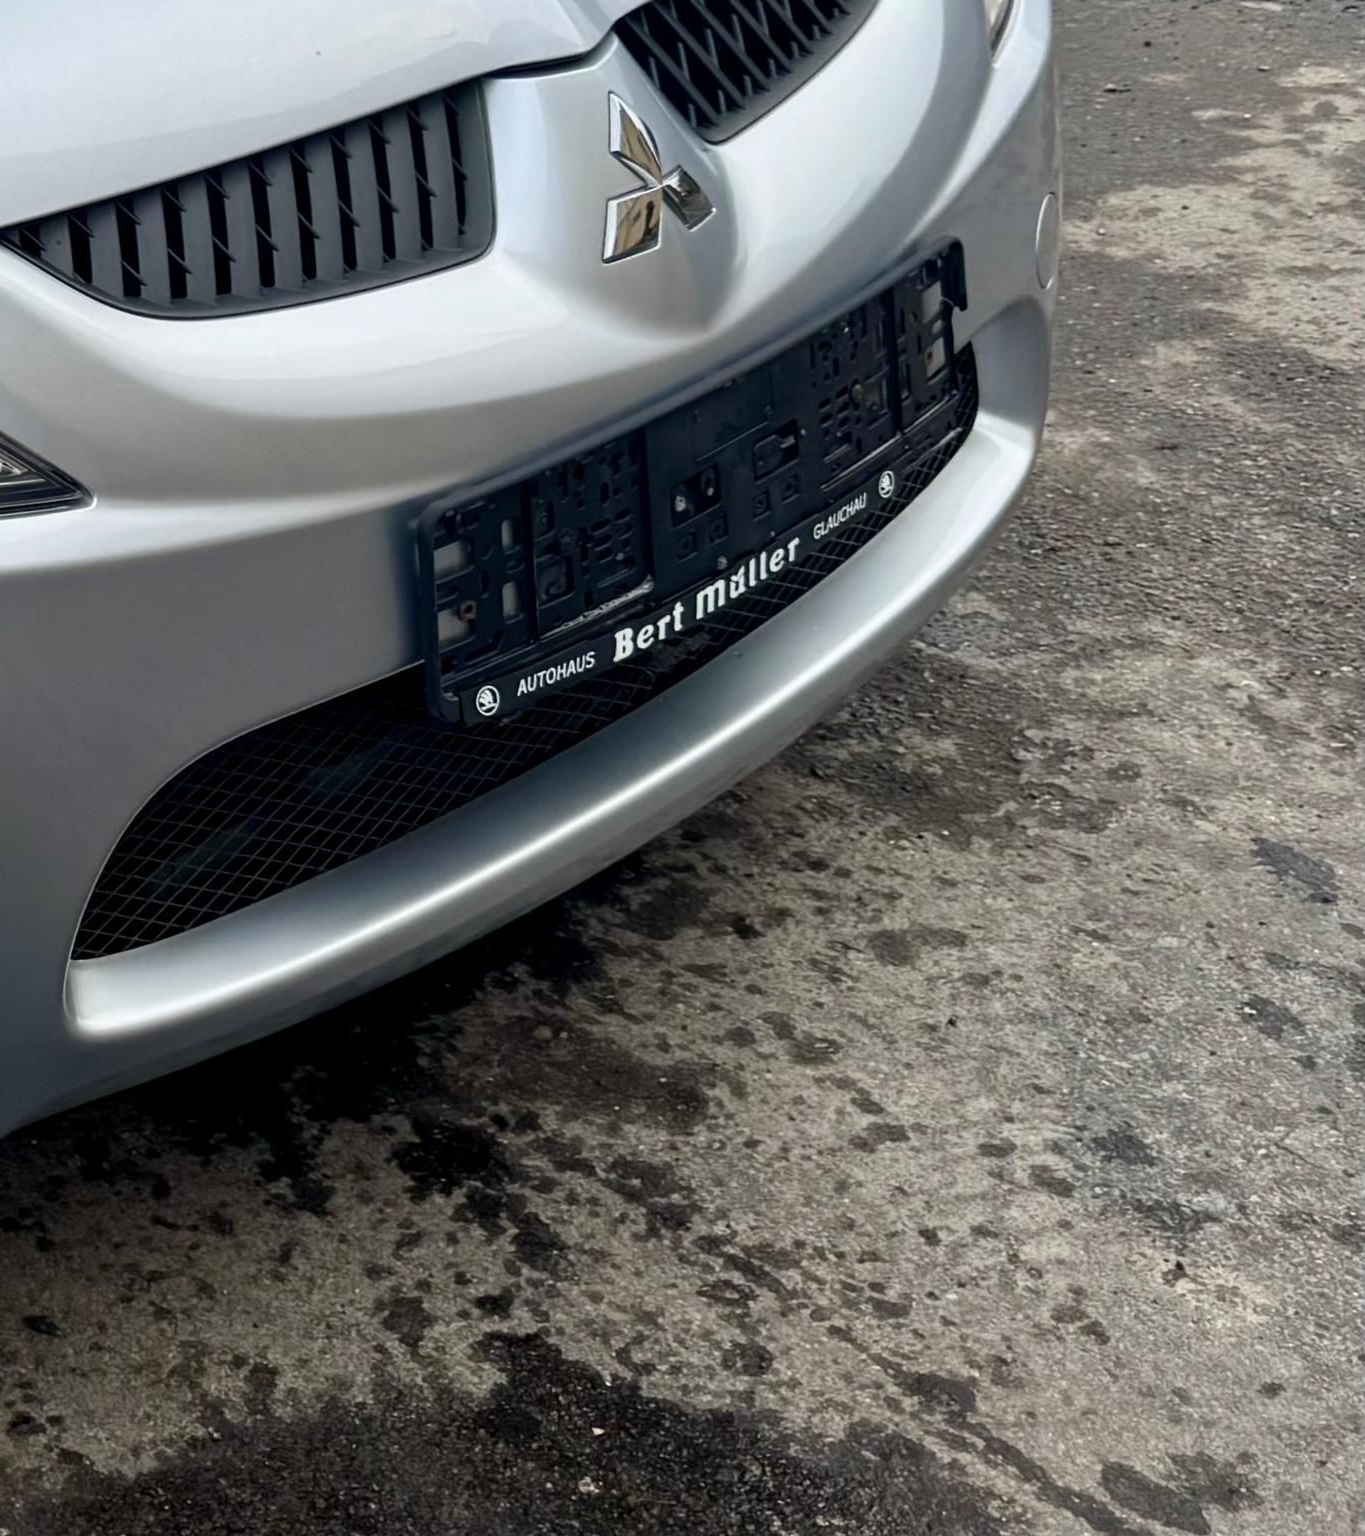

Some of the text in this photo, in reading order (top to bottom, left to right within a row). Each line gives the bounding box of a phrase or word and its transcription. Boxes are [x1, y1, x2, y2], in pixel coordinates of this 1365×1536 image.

[516, 650, 596, 697] AUTOHAUS
[612, 600, 684, 663] Bert
[812, 492, 867, 540] GLAUCHAU
